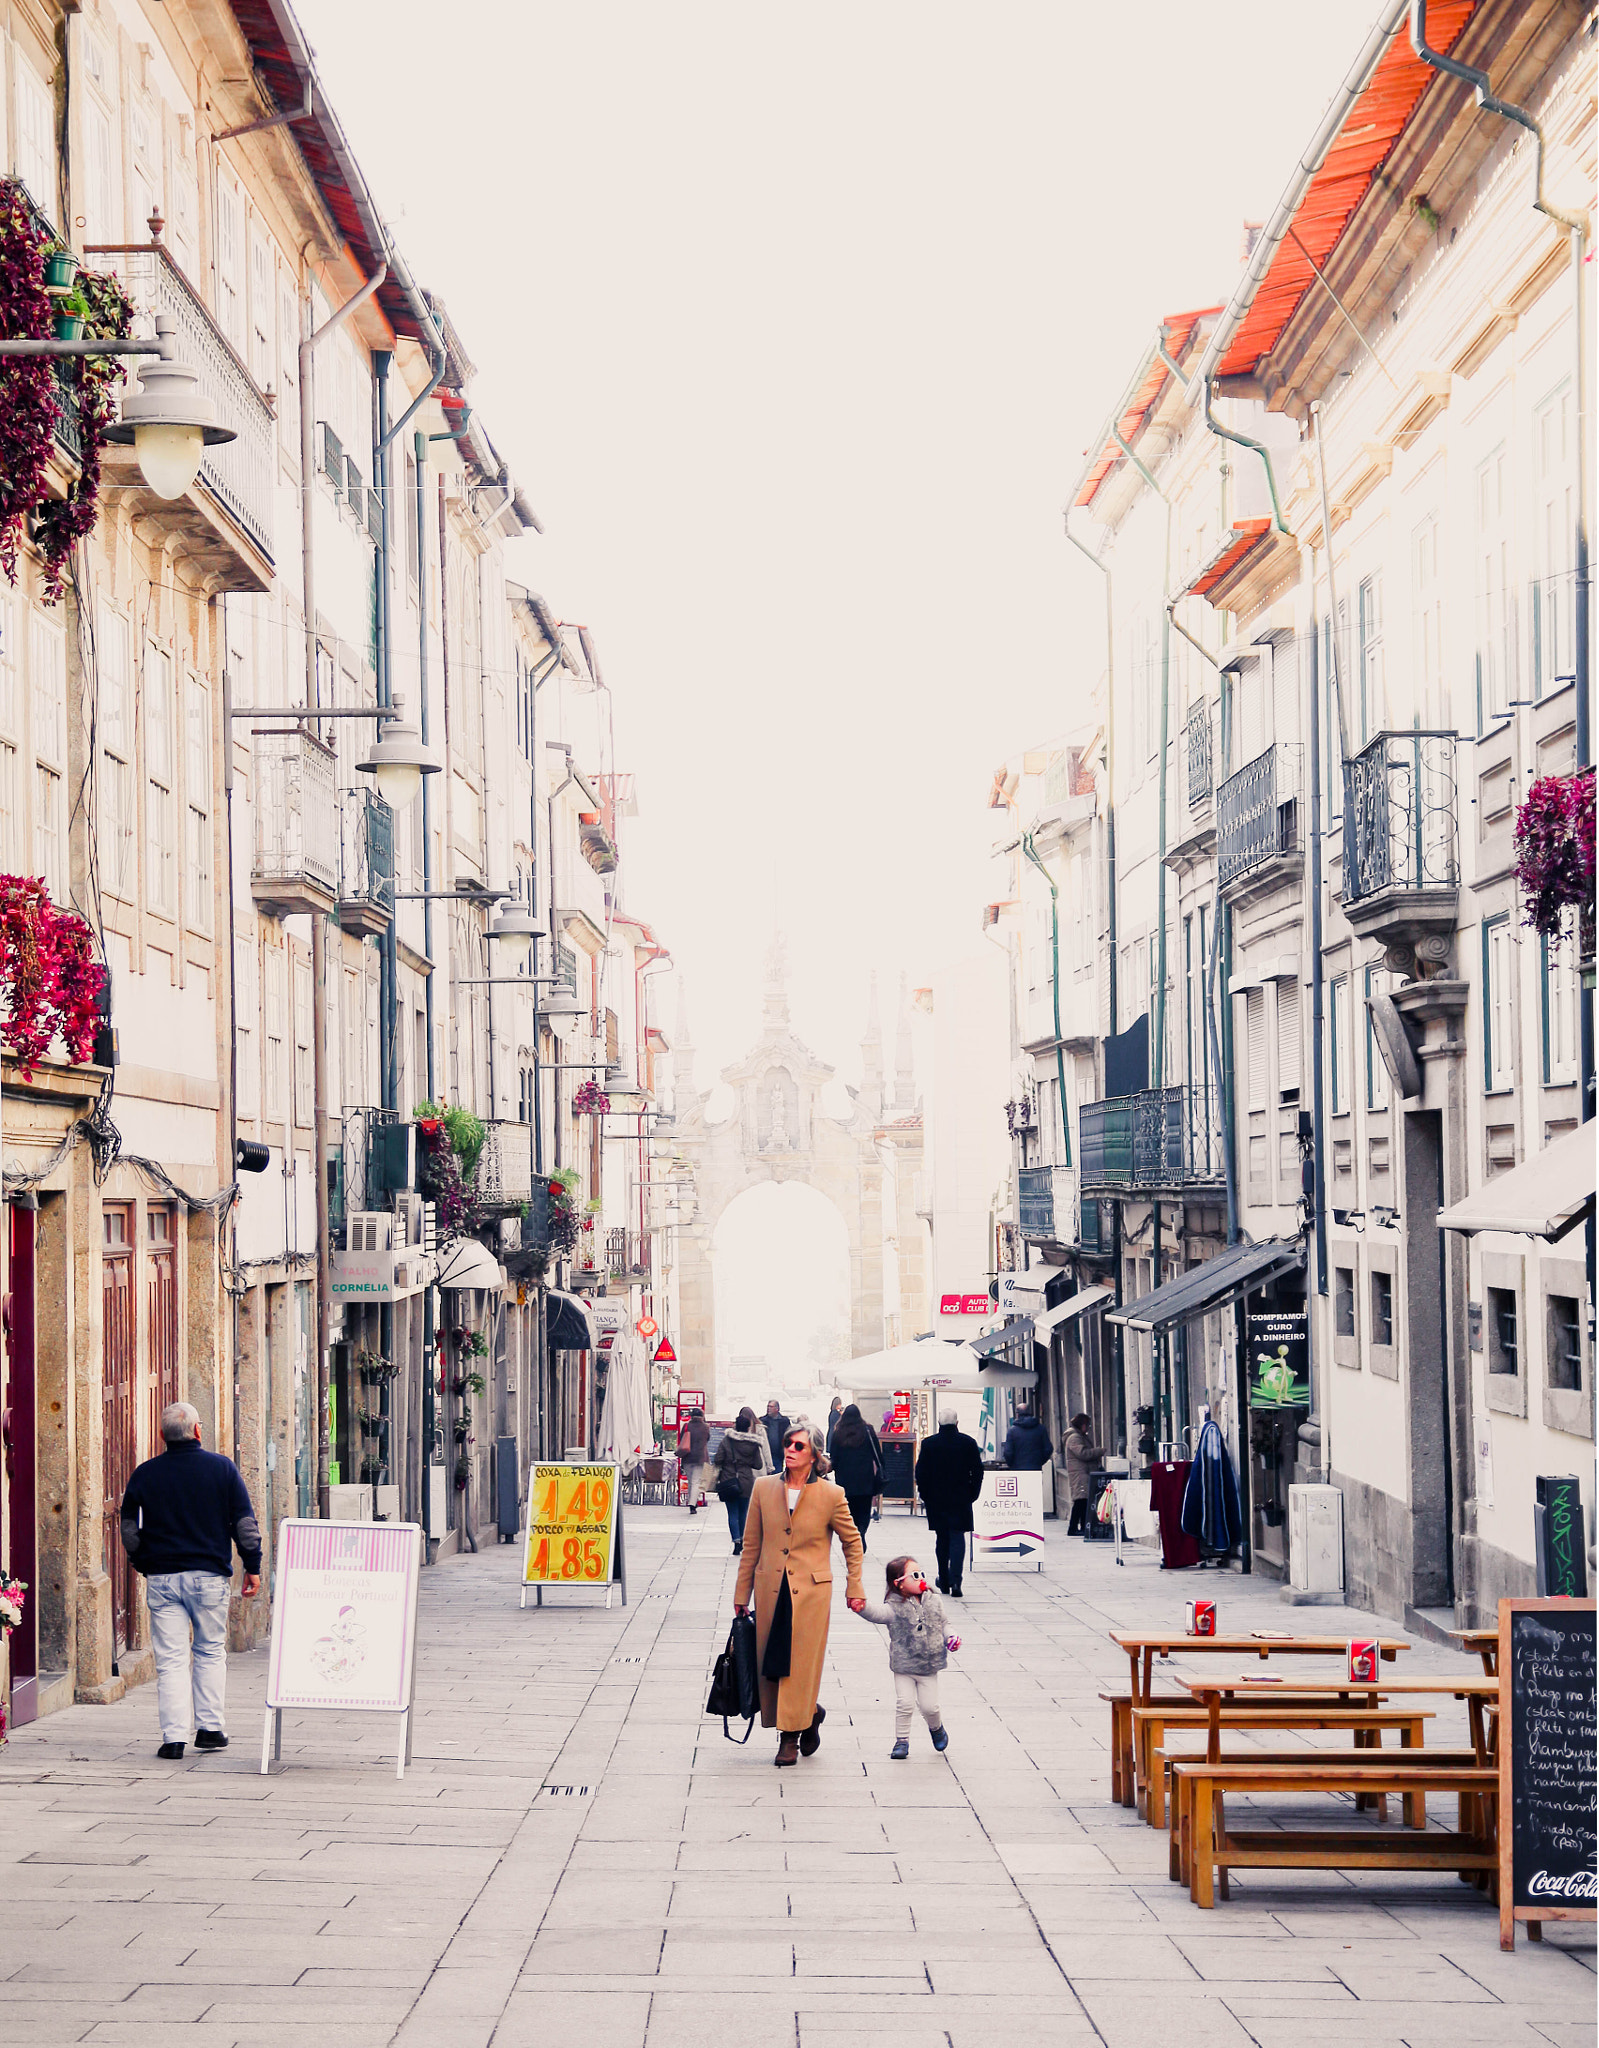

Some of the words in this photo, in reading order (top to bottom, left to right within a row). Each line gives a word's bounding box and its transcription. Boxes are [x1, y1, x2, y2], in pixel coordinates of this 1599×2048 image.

[342, 1267, 379, 1276] TALHO
[332, 1282, 389, 1292] CORNÉLIA
[1251, 1312, 1307, 1321] COMPRAMOS
[1267, 1323, 1293, 1331] OURO
[1254, 1334, 1261, 1342] A
[1263, 1333, 1306, 1341] DINHEIRO
[535, 1467, 561, 1478] COXA
[571, 1466, 612, 1479] FRANGO
[540, 1479, 612, 1523] 1.49
[983, 1500, 1031, 1508] AGTEXTIL
[530, 1525, 564, 1535] PORCO
[532, 1537, 605, 1580] 1.85
[351, 1589, 399, 1602] Portugal
[1528, 1870, 1597, 1898] Coca-Cola
